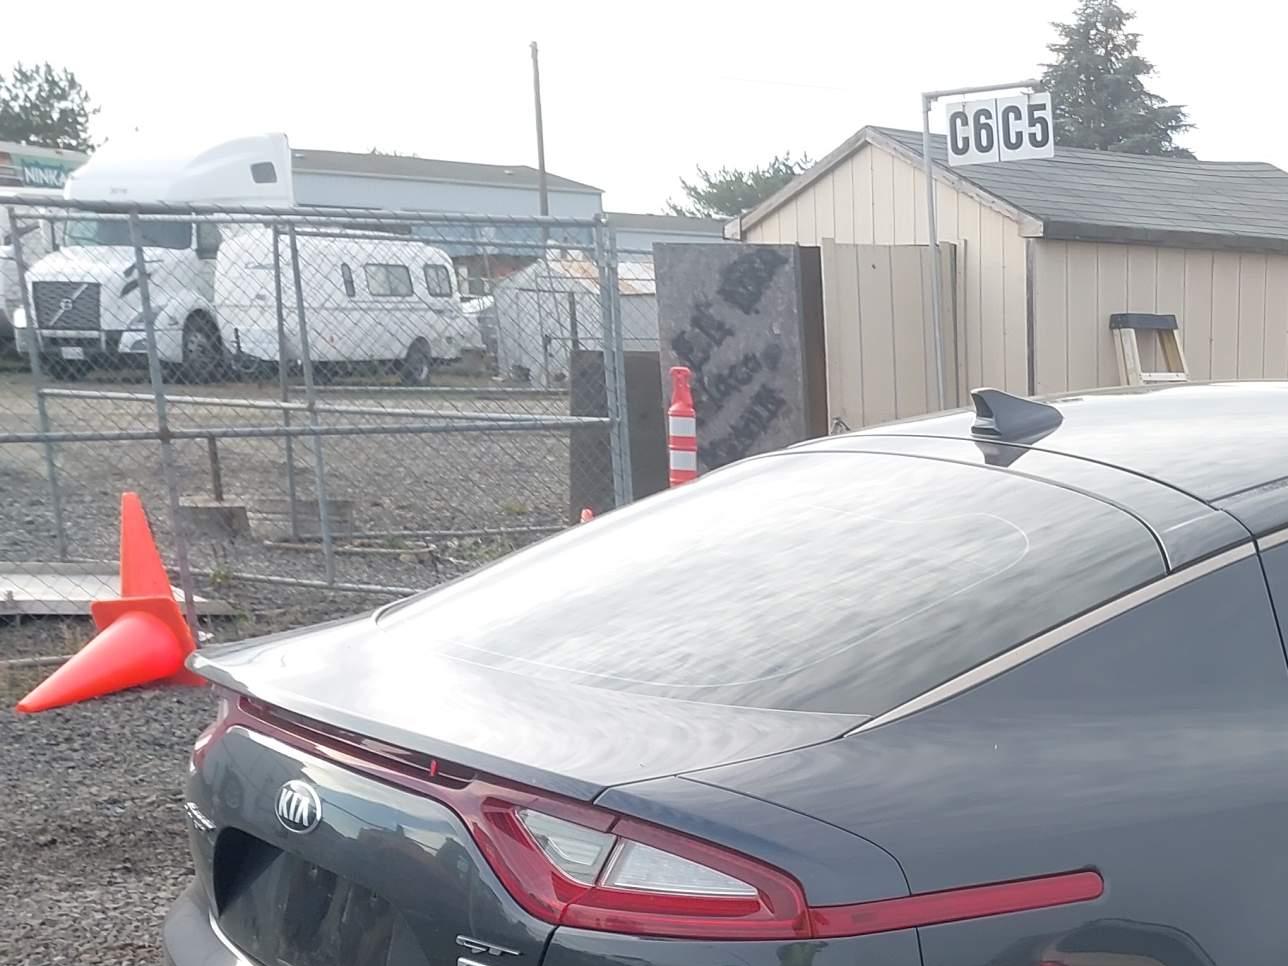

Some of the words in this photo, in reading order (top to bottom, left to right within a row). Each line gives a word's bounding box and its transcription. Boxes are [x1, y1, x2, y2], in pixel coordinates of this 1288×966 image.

[949, 108, 994, 155] C6
[1001, 103, 1049, 150] C5
[277, 786, 311, 828] KIA
